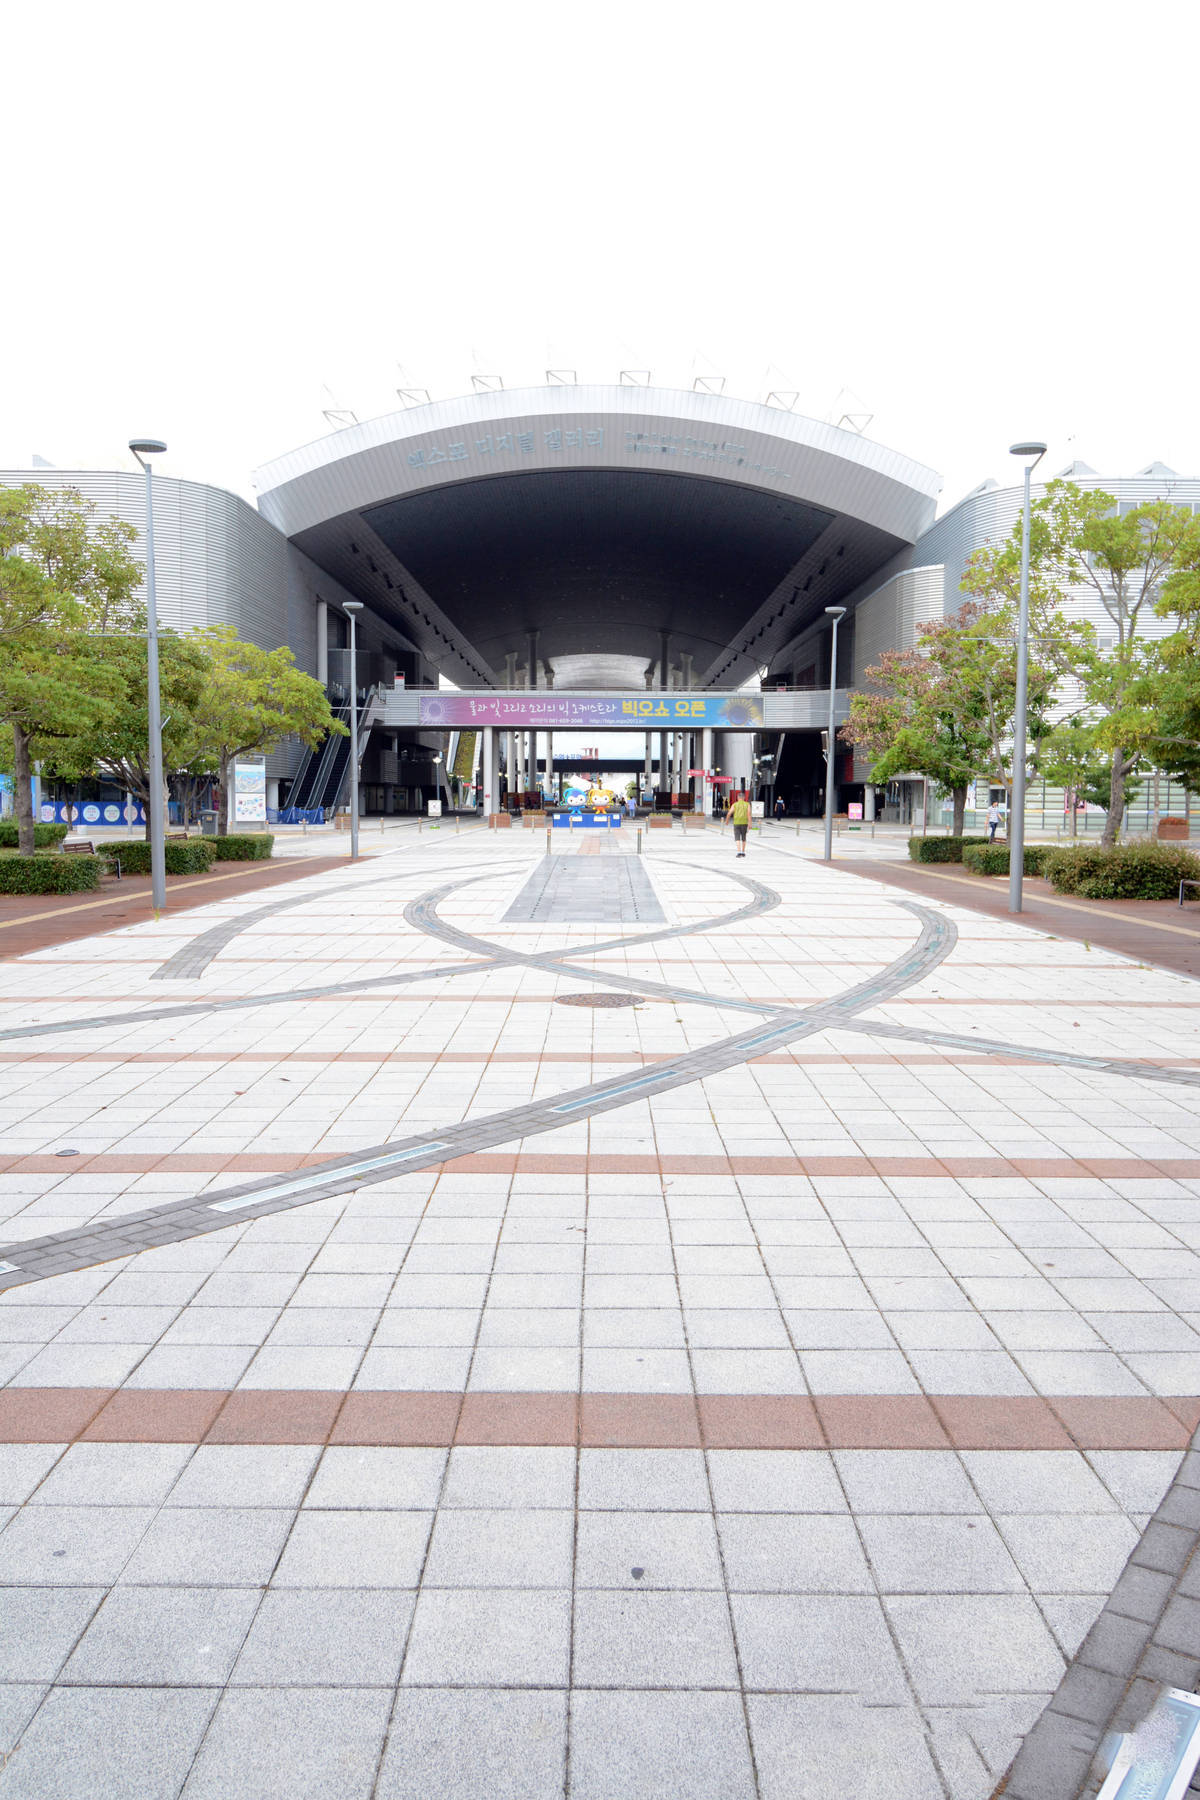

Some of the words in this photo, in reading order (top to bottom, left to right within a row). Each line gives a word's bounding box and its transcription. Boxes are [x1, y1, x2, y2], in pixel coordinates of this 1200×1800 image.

[408, 442, 469, 469] 엑스포
[476, 431, 535, 455] 디지털
[544, 428, 605, 451] 갤러리
[470, 700, 488, 716] 물과
[503, 702, 528, 713] 그리고
[529, 702, 556, 713] 소리의
[559, 701, 570, 716] 빅
[572, 702, 618, 714] 오케스트라
[622, 700, 670, 717] 빅오쇼
[674, 700, 706, 717] 오픈
